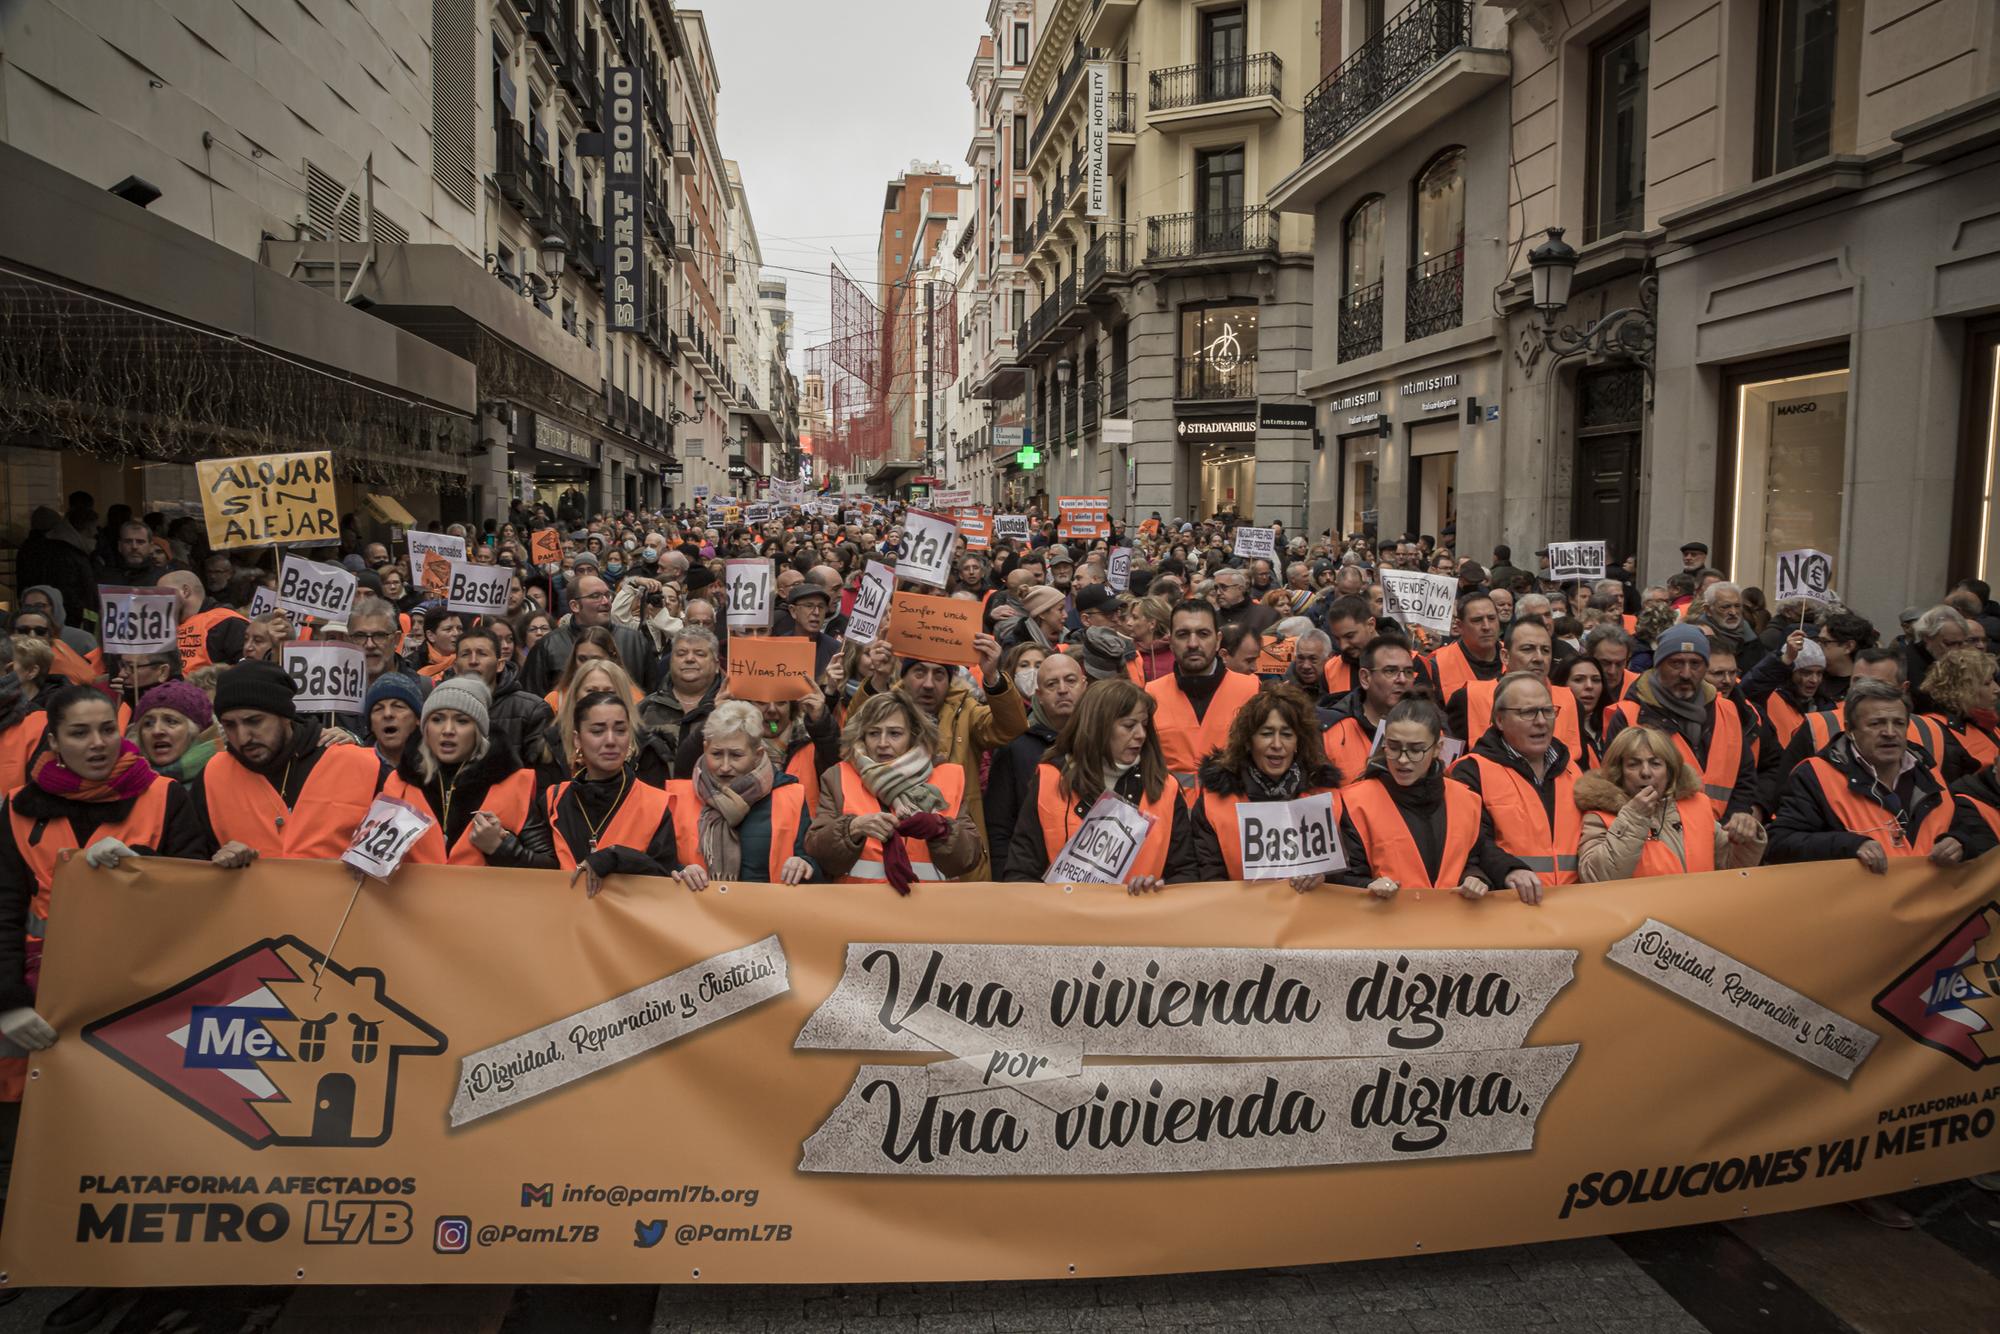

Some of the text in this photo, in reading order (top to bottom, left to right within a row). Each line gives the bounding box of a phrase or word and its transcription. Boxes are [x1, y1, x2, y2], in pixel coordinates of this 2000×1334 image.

[1093, 72, 1103, 210] PETITPALACE HOTELITY
[613, 72, 634, 327] SPORT 2000
[1330, 390, 1380, 413] intimissimi
[1400, 374, 1458, 396] intimissimi
[1263, 419, 1308, 427] intimissimi
[1777, 402, 1817, 416] MANGO
[1187, 421, 1257, 434] STRADIVARIUS
[1551, 546, 1605, 569] ¡Justicia!
[281, 568, 354, 611] Basta!
[450, 573, 511, 605] Basta!
[1389, 598, 1423, 611] PISO
[105, 601, 173, 641] Basta!
[288, 656, 365, 698] Basta!
[1077, 823, 1126, 868] DIGNA
[1244, 807, 1337, 862] Basta!
[680, 992, 698, 1019] y
[861, 949, 1521, 1050] Una vivienda digna
[198, 1016, 288, 1057] Me
[1795, 1020, 1812, 1045] y
[982, 1049, 1050, 1086] por
[861, 1060, 1530, 1165] Una vivienda digna.
[1878, 1091, 1978, 1125] PLATAFORMA
[1874, 1107, 1996, 1160] METRO
[79, 1175, 417, 1195] PLATAFORMA AFECTADOS
[1558, 1135, 1870, 1219] ¡SOLUCIONES YA!
[561, 1183, 760, 1207] info@paml7b.org
[75, 1199, 414, 1246] METRO L7B
[476, 1224, 600, 1247] @PamL7B
[674, 1223, 793, 1246] @PamL7B
